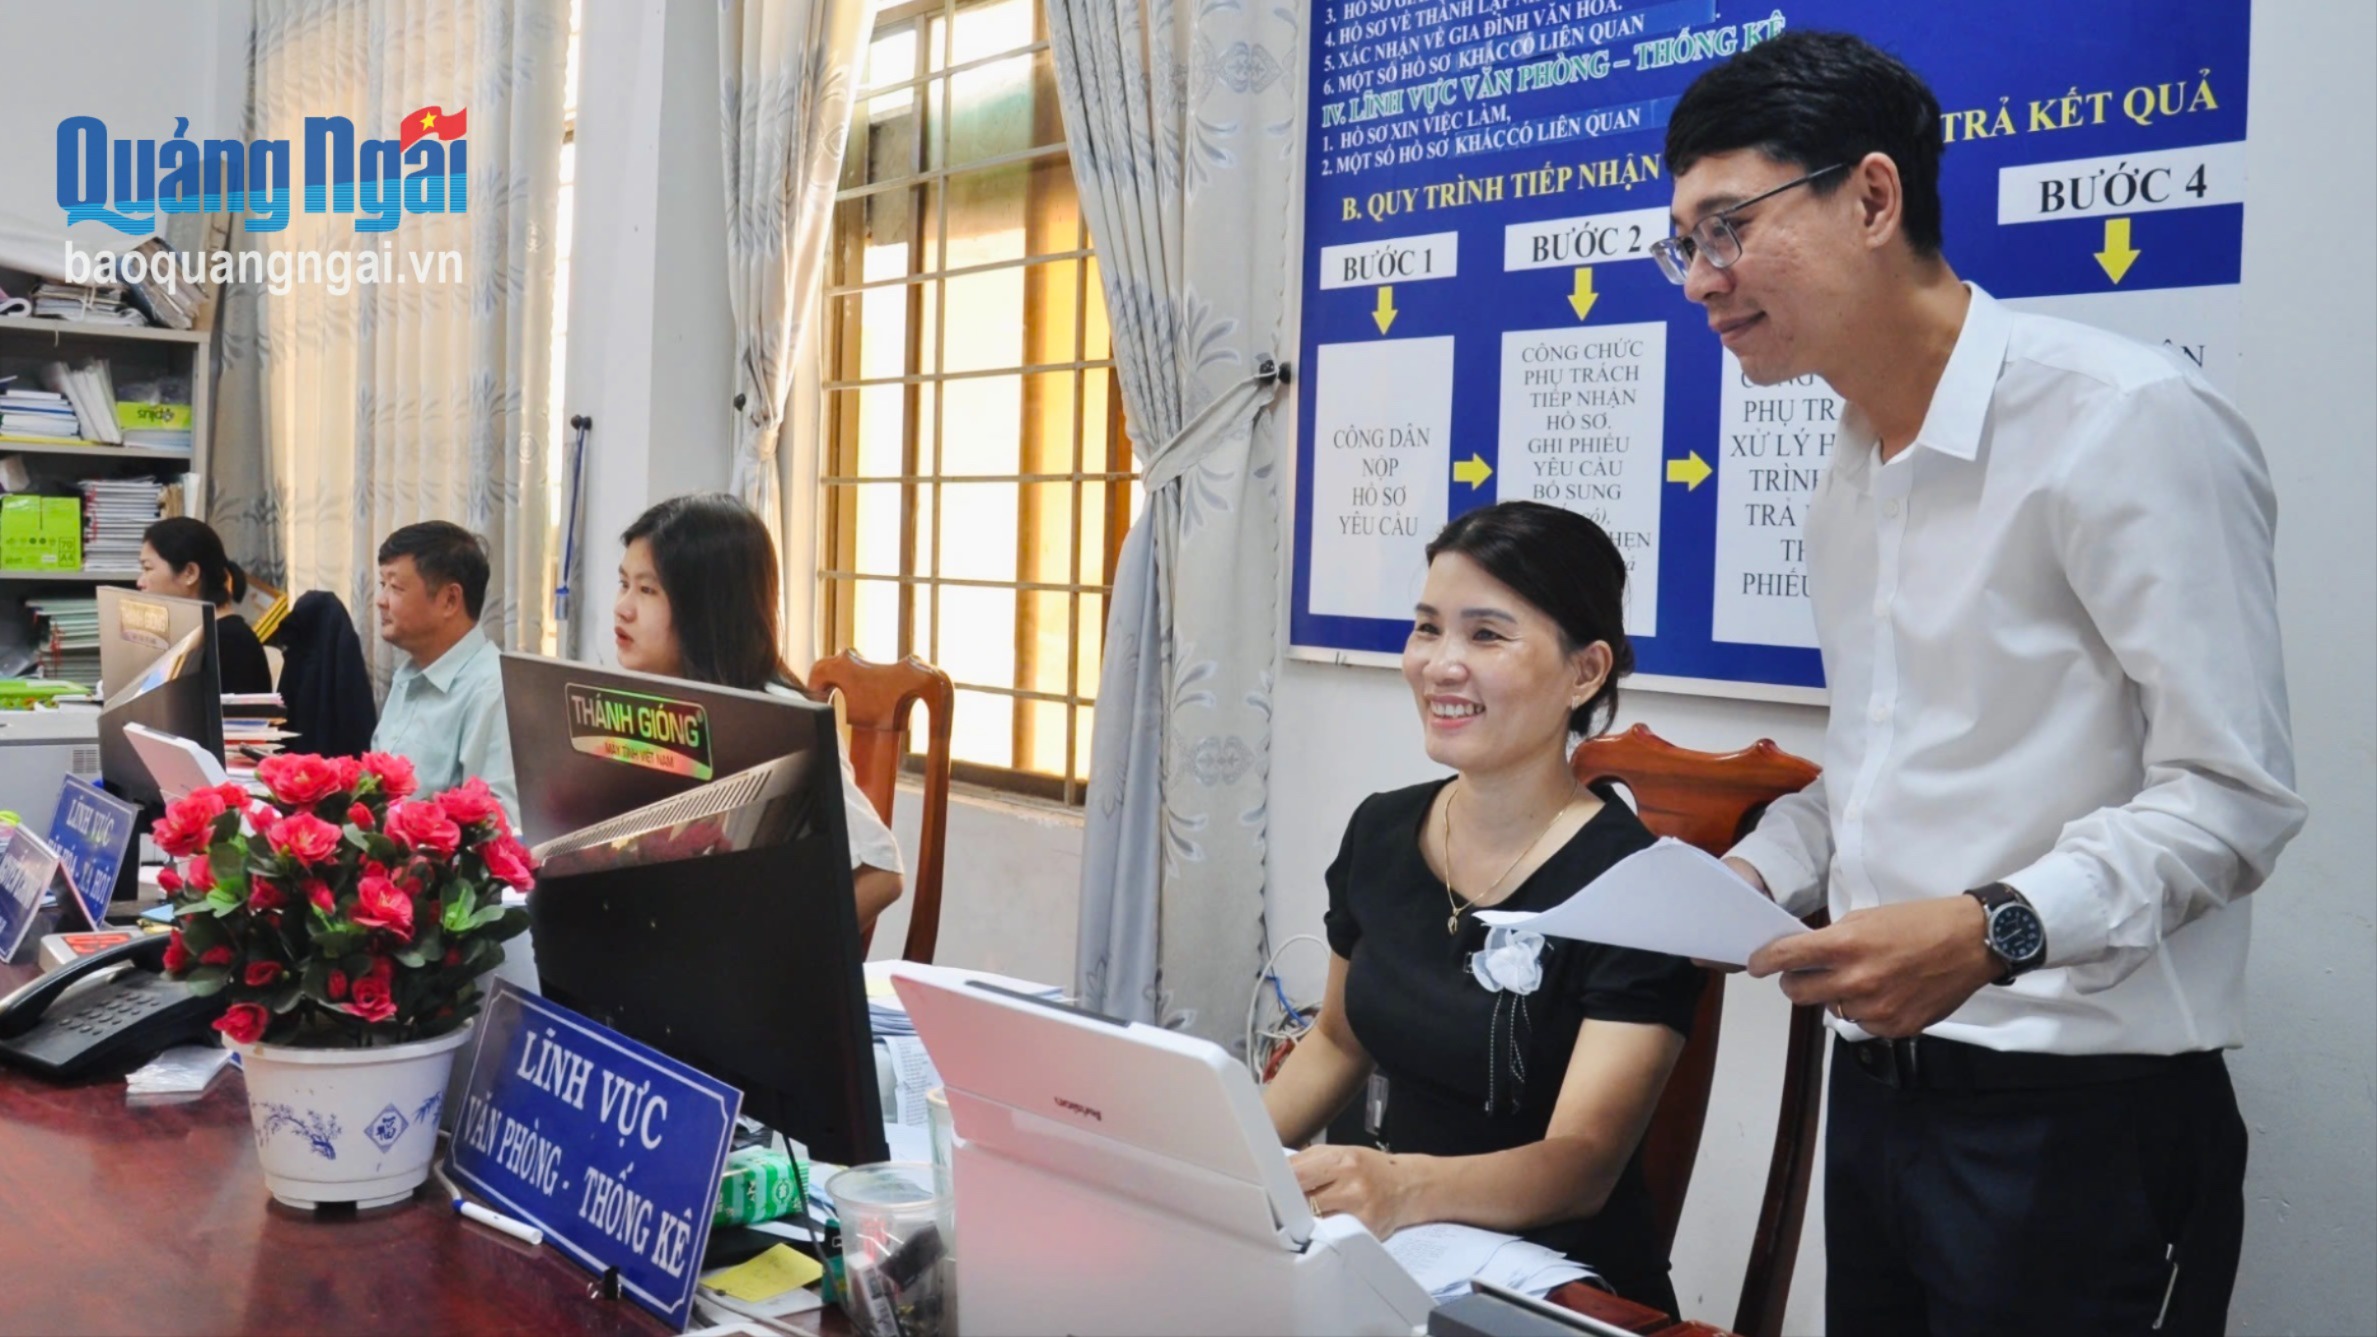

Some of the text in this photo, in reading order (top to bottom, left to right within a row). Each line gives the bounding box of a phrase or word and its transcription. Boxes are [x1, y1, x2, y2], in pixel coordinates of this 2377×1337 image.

[1324, 58, 1335, 72] 5.
[1338, 46, 1371, 68] XÁC
[1374, 36, 1420, 61] NHẬN
[1424, 26, 1445, 50] VỀ
[1448, 24, 1480, 45] GIA
[1484, 12, 1528, 38] ĐÌNH
[1532, 2, 1571, 27] VĂN
[1325, 32, 1336, 47] 4.
[1340, 21, 1362, 45] HỒ
[1365, 17, 1388, 39] SƠ
[1390, 9, 1411, 32] VỀ
[1415, 0, 1473, 28] THÀNH
[1323, 80, 1334, 95] 6.
[1338, 70, 1374, 94] MỘT
[1377, 62, 1397, 85] SỐ
[1402, 59, 1425, 80] HỒ
[1429, 53, 1451, 73] SƠ
[1540, 24, 1584, 51] LIÊN
[1589, 14, 1645, 45] QUAN
[1321, 102, 1346, 128] IV.
[1348, 89, 1404, 124] LĨNH
[1407, 76, 1458, 115] VỰC
[1461, 66, 1513, 102] VĂN
[1517, 50, 1611, 93] PHÒNG
[1633, 25, 1739, 71] THỐNG
[1321, 160, 1333, 176] 2.
[1336, 152, 1372, 176] MỘT
[1374, 143, 1395, 167] SỐ
[1400, 140, 1423, 163] HỒ
[1426, 137, 1449, 159] SƠ
[1537, 115, 1581, 141] LIÊN
[1585, 107, 1641, 136] QUAN
[1322, 102, 1511, 152] 1. HỒ SƠ XIN VIỆC LÀM,
[1342, 68, 2219, 222] B. QUY TRÌNH TIẾP NHẬN TRẢ KẾT QUẢ
[2038, 161, 2207, 214] BƯỚC 4
[1532, 221, 1642, 263] BƯỚC 2
[1343, 244, 1432, 283] BƯỚC 1
[1522, 338, 1644, 363] CÔNG CHỨC
[1524, 362, 1640, 388] PHỤ TRÁCH
[1530, 387, 1637, 409] TIẾP NHẬN
[1743, 399, 1795, 427] PHỤ
[1546, 409, 1575, 430] HỒ
[1333, 422, 1430, 449] CÔNG DÂN
[1528, 432, 1630, 454] GHI PHIẾU
[1730, 427, 1771, 458] XỬ
[1776, 427, 1810, 457] LÝ
[1362, 454, 1399, 481] NỘP
[1533, 456, 1623, 476] YÊU CẦU
[1352, 481, 1407, 507] HỒ SƠ
[1566, 484, 1622, 500] SUNG
[1338, 510, 1418, 537] YÊU CẦU
[1745, 497, 1796, 527] TRẢ
[571, 693, 635, 735] THÁNH
[656, 754, 674, 768] NAM
[517, 1027, 668, 1150] LĨNH VỰC
[463, 1090, 501, 1157] VĂN
[496, 1118, 562, 1197] PHÒNG
[579, 1162, 653, 1254] THỐNG
[651, 1207, 692, 1279] KÊ
